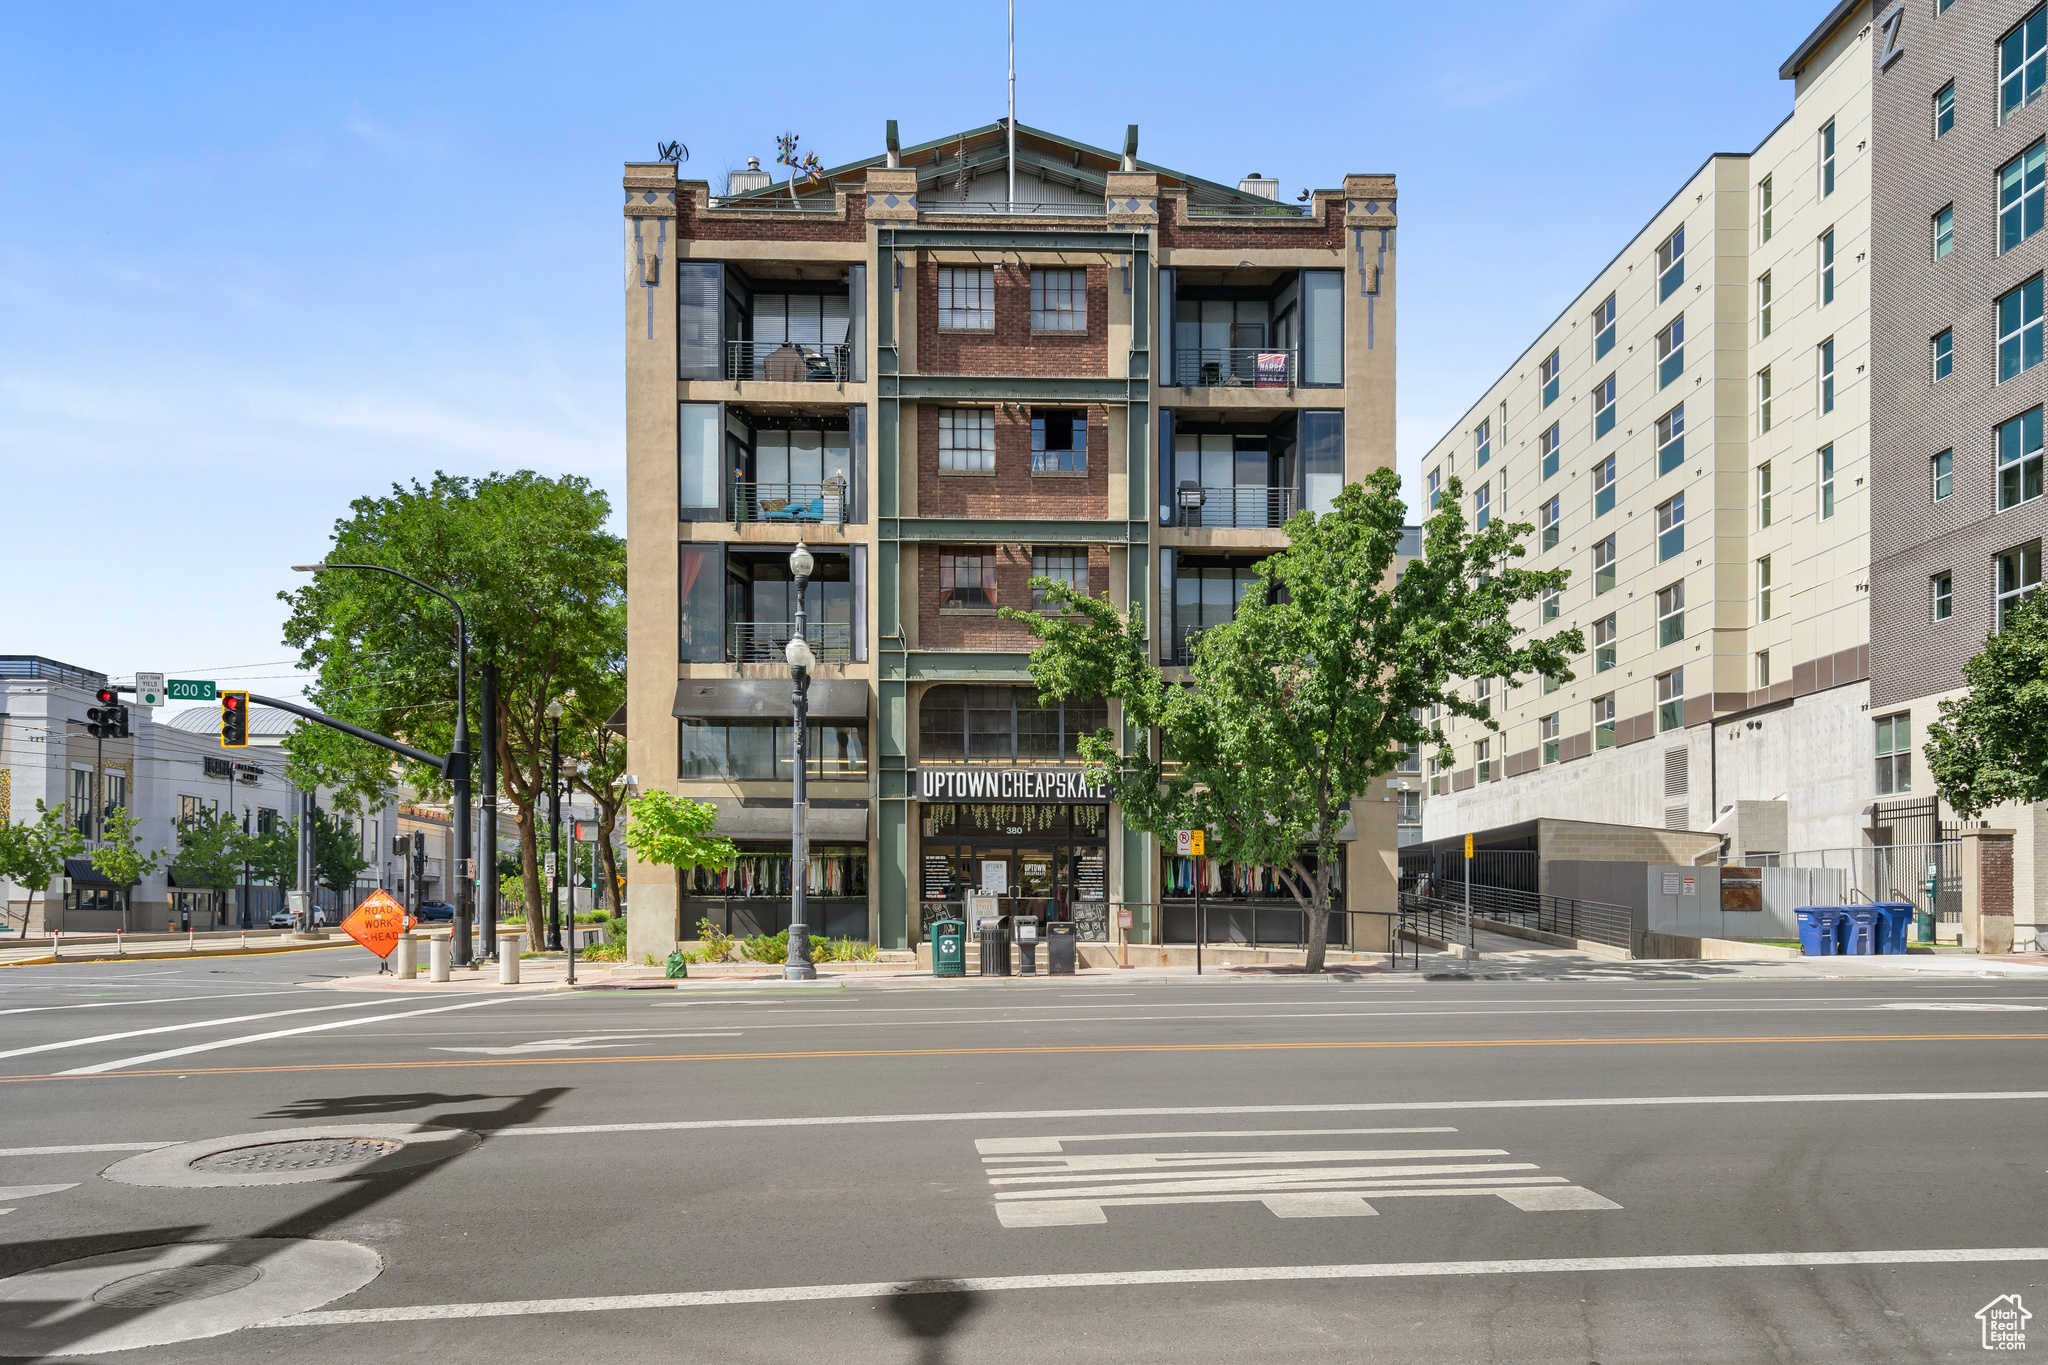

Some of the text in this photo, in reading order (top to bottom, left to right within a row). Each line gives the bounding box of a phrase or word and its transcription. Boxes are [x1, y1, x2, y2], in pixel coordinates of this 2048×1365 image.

[173, 683, 211, 697] 200 S
[923, 772, 998, 798] UPTOWN
[546, 865, 554, 874] 25
[365, 906, 393, 915] ROAD
[365, 919, 393, 928] WORK
